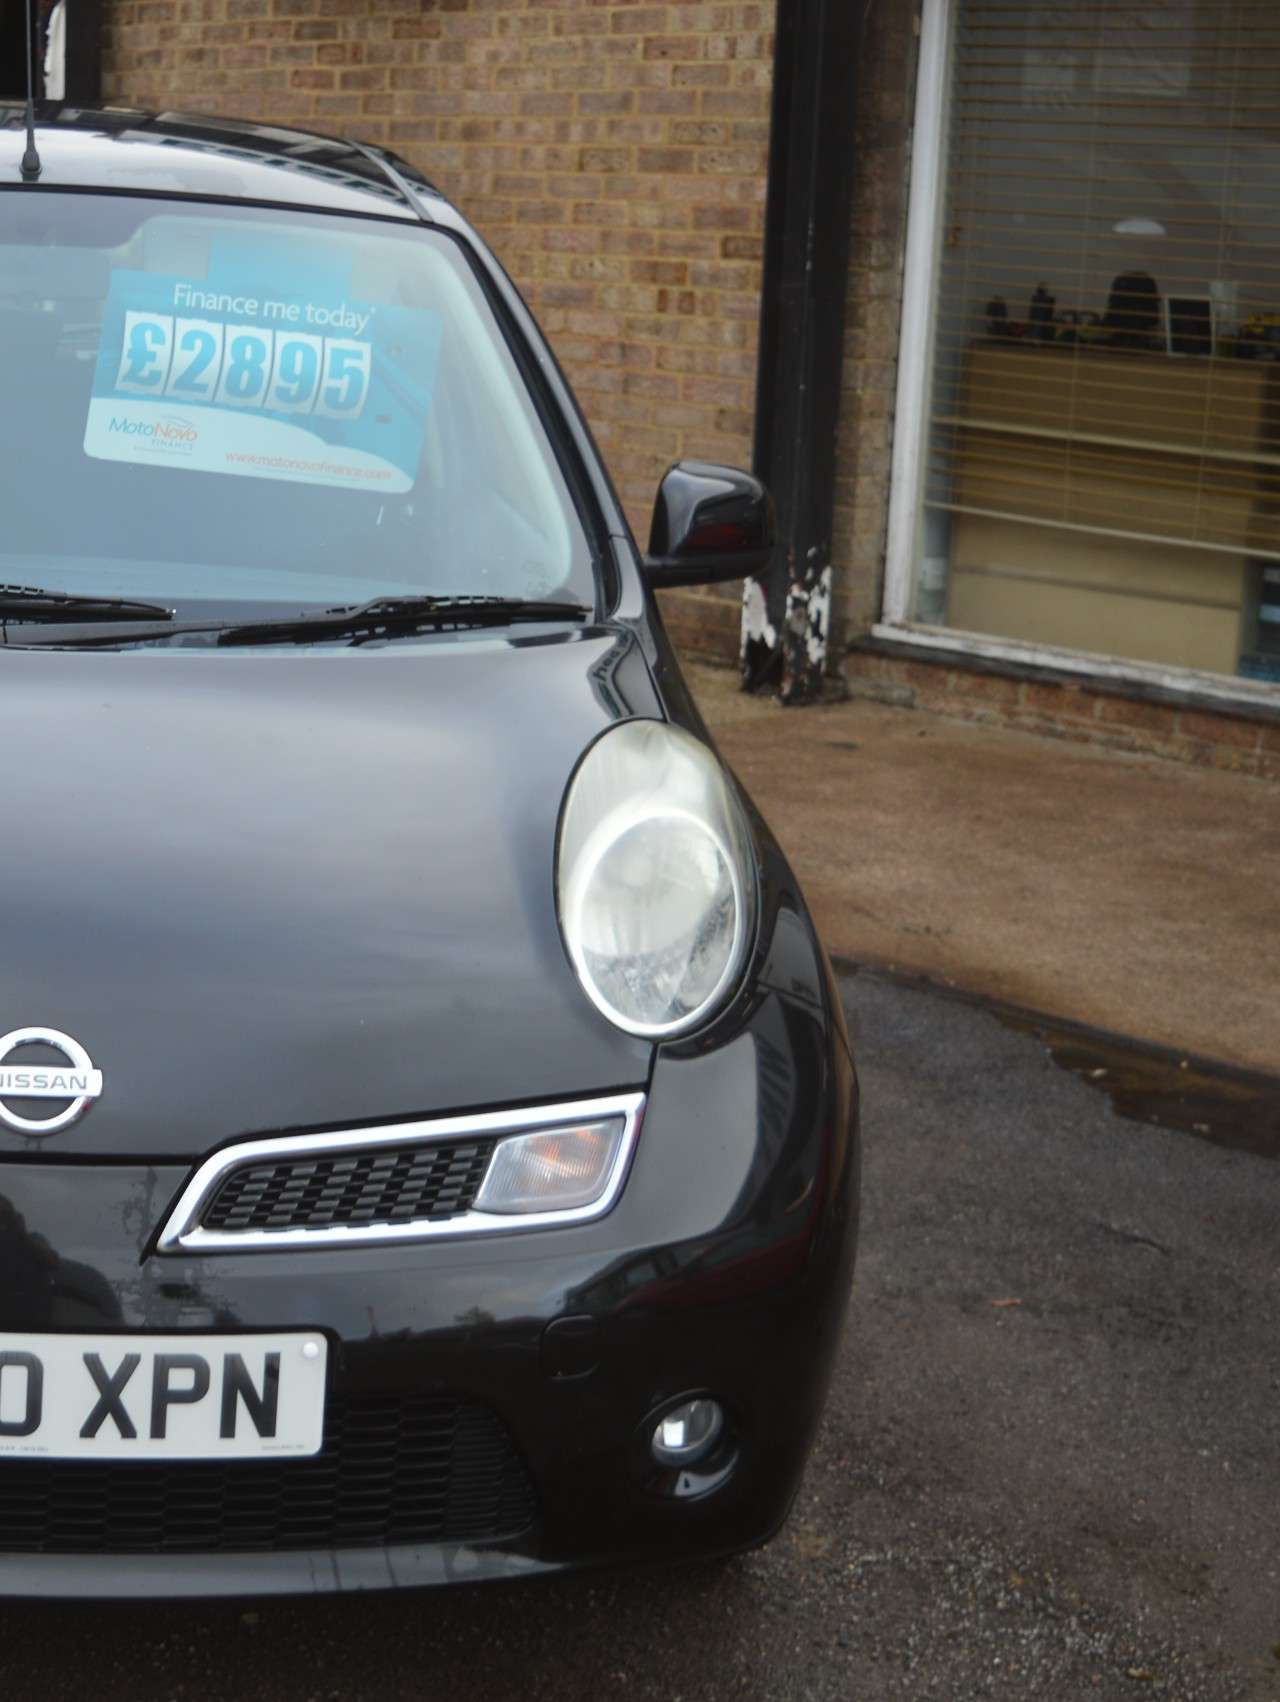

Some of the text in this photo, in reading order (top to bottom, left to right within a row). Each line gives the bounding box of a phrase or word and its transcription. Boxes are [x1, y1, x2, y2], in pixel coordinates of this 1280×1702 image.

[173, 284, 258, 315] Finance
[263, 300, 300, 318] me
[122, 321, 366, 411] £2895
[109, 416, 198, 442] MotoNovo
[79, 1351, 282, 1439] XPN
